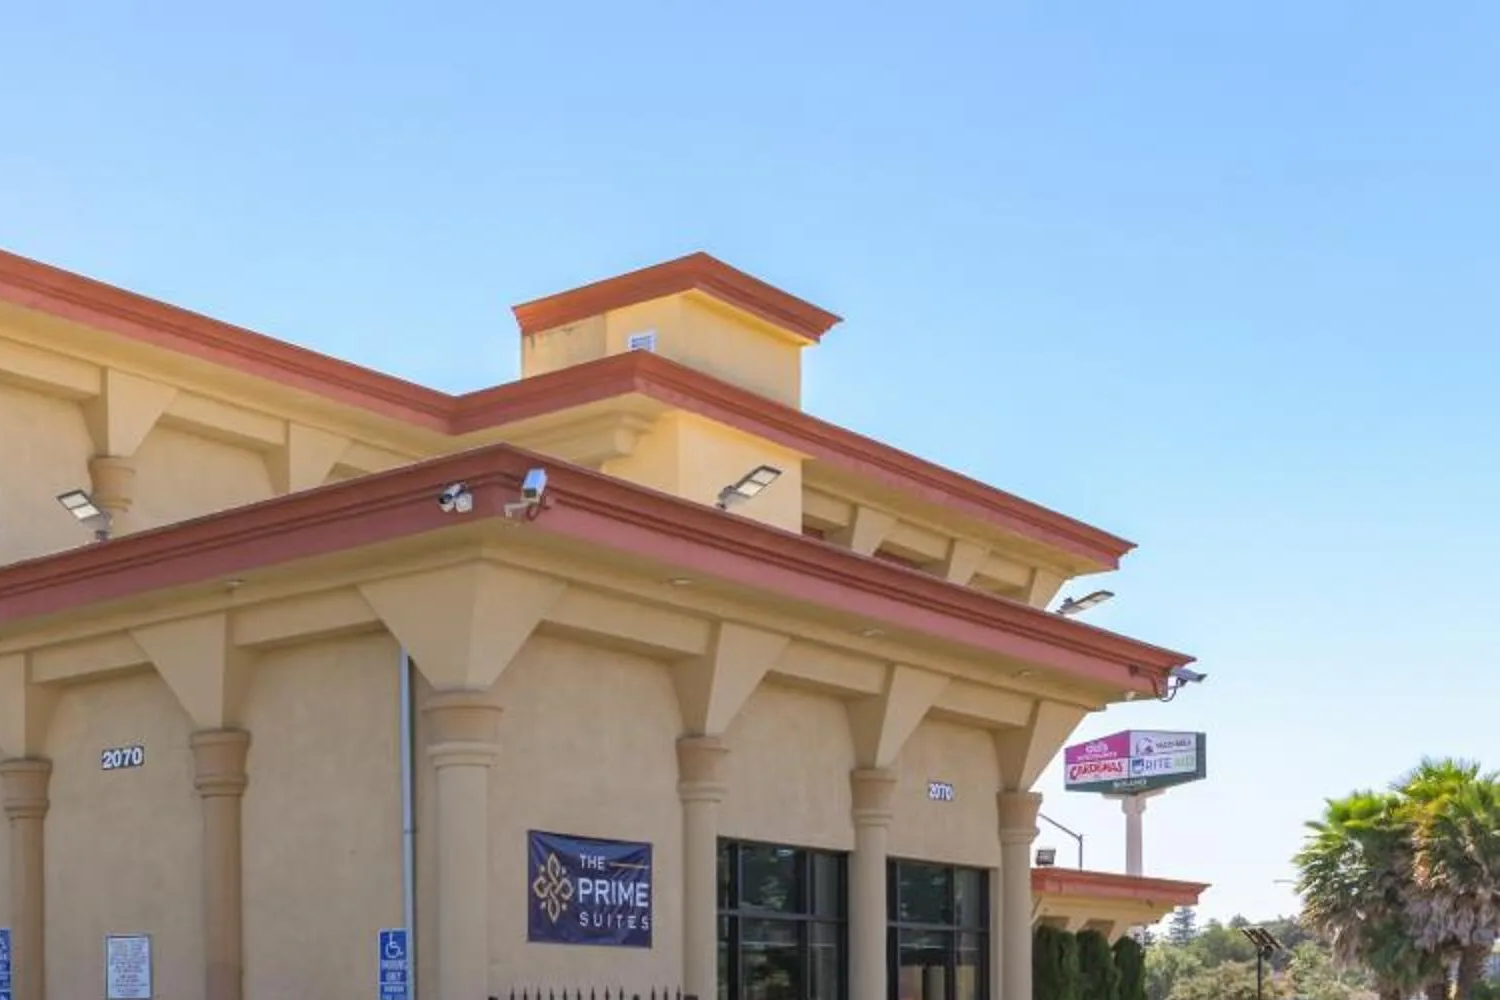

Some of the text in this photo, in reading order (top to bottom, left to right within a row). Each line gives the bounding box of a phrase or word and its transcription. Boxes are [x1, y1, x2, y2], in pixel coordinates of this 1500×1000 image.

[103, 747, 143, 769] 2070
[579, 854, 606, 870] THE
[577, 877, 650, 908] PRIME
[579, 912, 650, 930] SUITES
